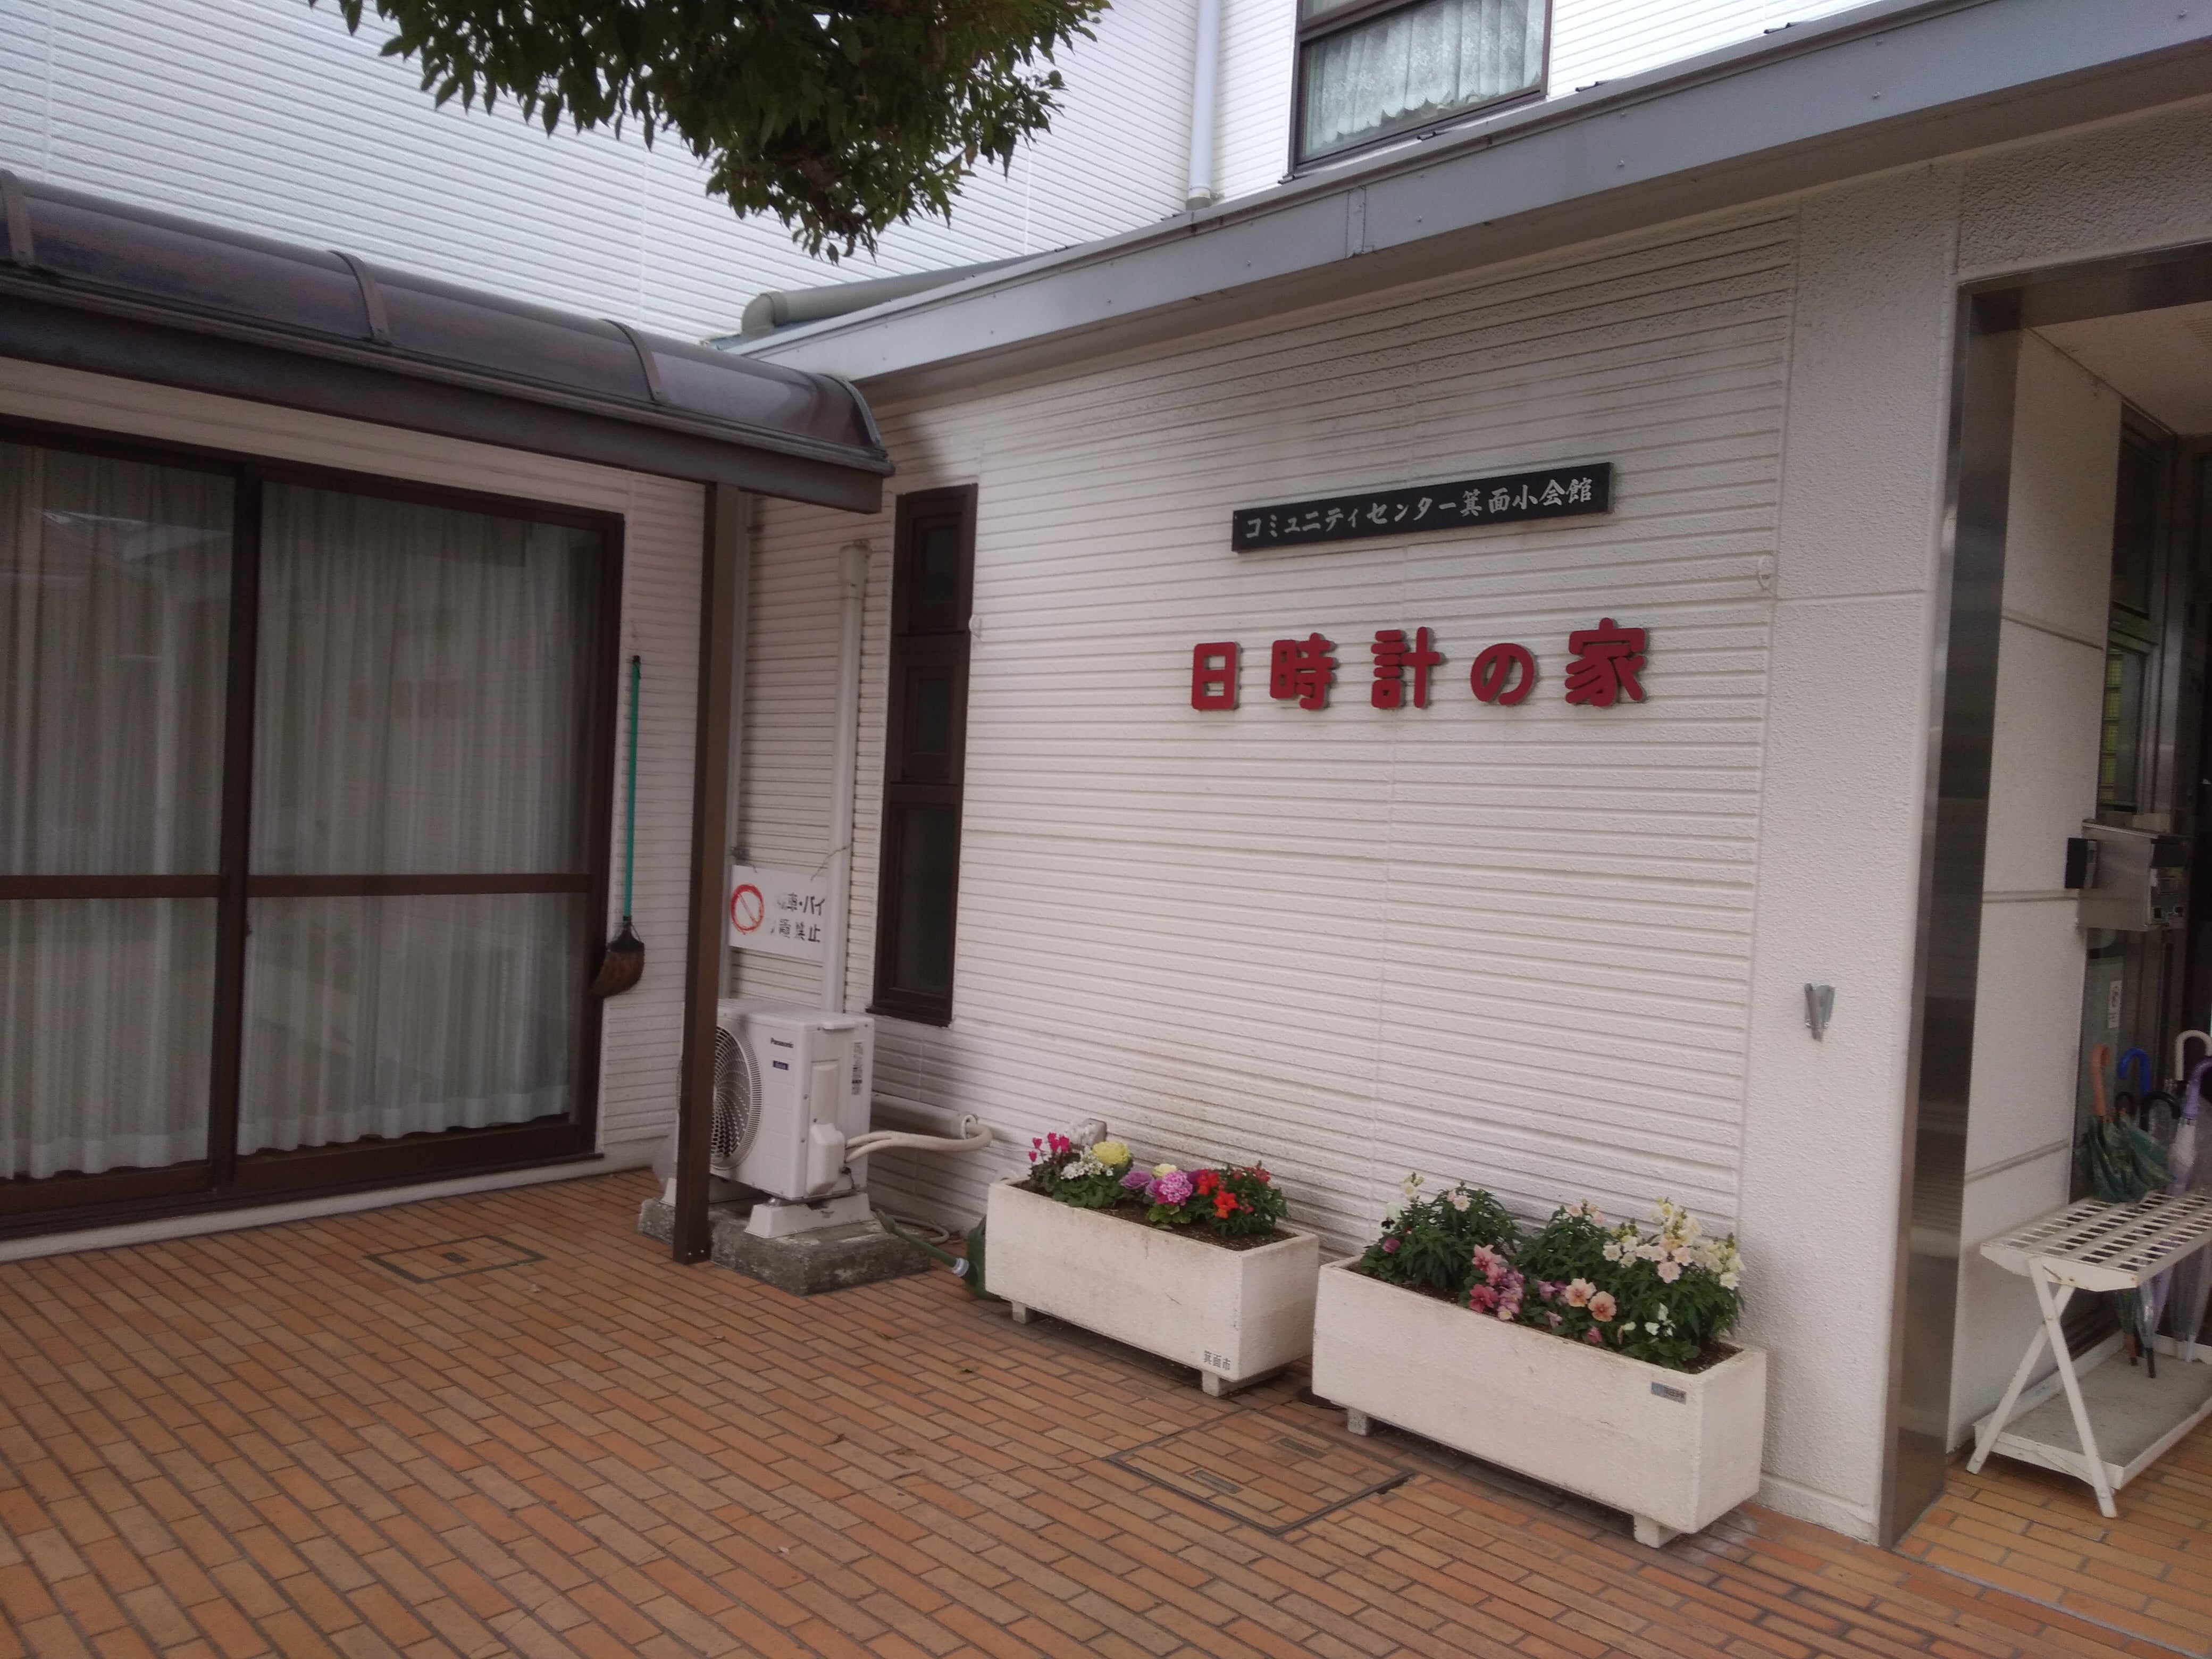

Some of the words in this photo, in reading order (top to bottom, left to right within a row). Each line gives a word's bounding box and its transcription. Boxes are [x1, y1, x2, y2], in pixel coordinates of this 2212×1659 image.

[1245, 476, 1593, 539] コミュニティセンター箕面小会館
[1191, 617, 1646, 710] 日時計の家
